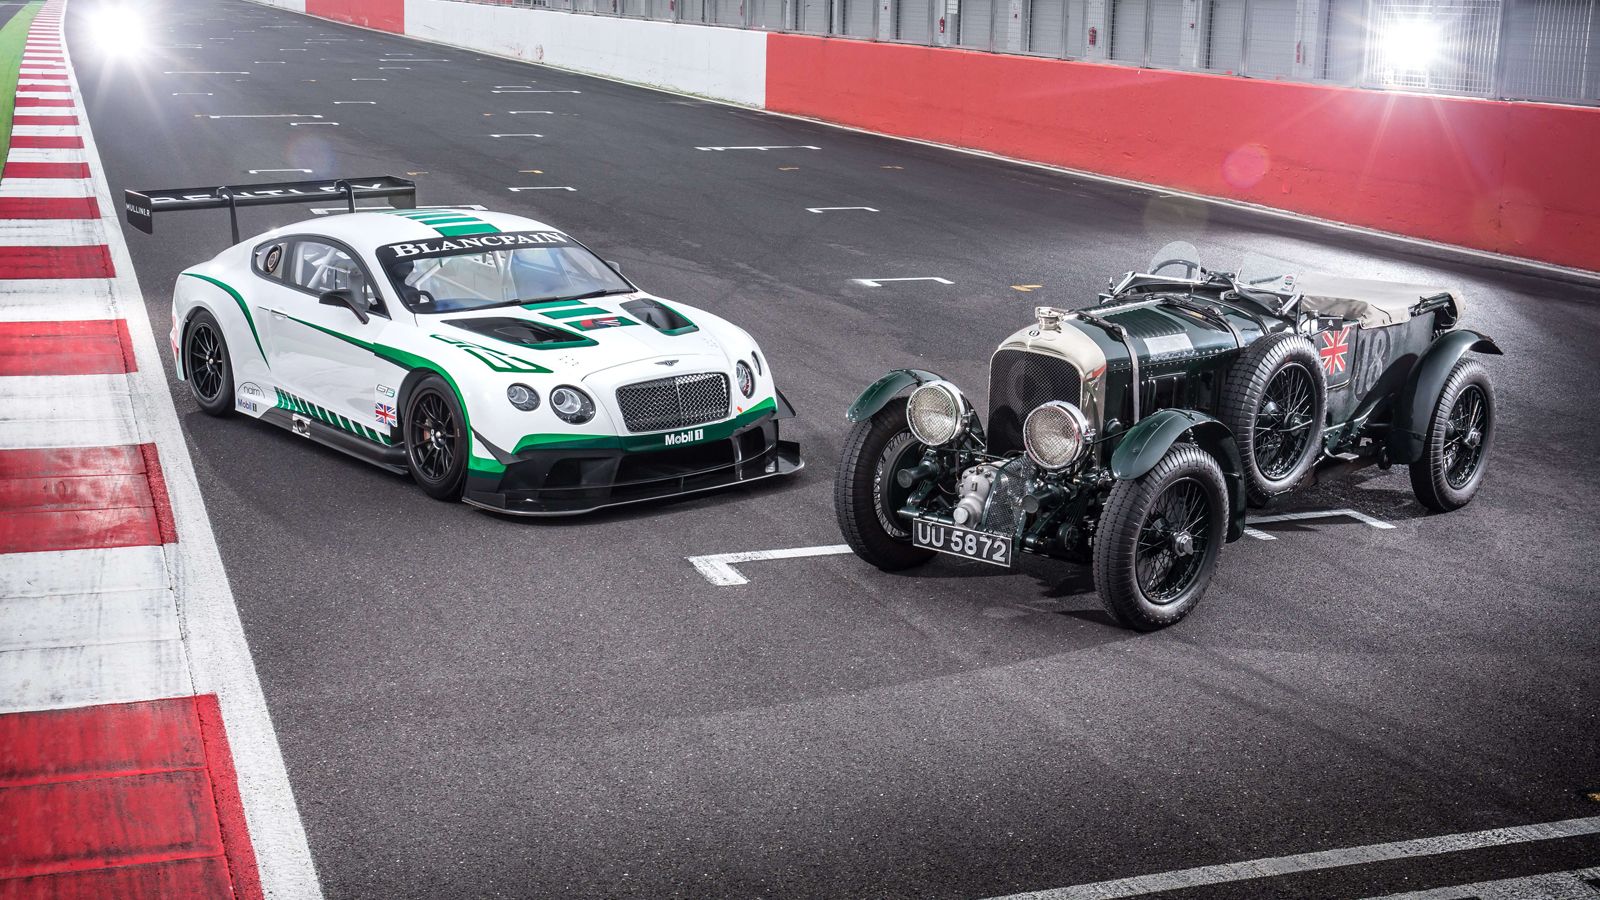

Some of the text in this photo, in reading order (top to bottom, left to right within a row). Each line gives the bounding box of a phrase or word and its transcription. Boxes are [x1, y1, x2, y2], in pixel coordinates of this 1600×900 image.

[125, 203, 151, 217] MULLINER
[389, 232, 567, 257] BLANCPAIN
[1356, 330, 1387, 394] 18
[243, 385, 261, 396] naim
[238, 398, 252, 410] Mobil
[665, 429, 704, 446] Mobil 1
[918, 522, 1006, 562] UU 5872
